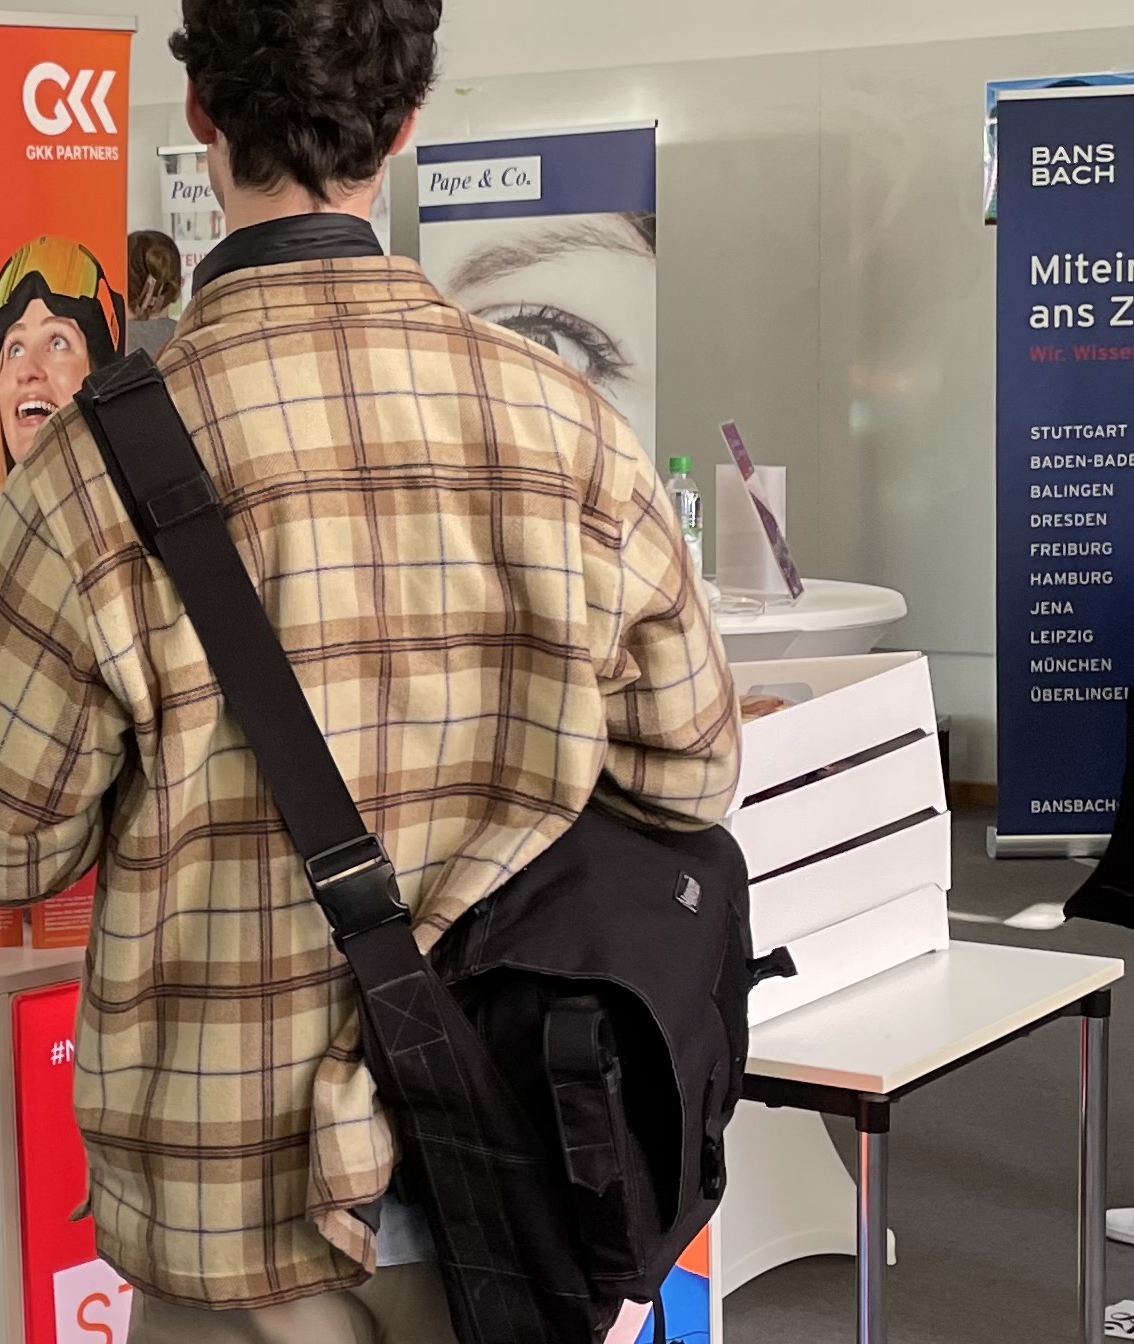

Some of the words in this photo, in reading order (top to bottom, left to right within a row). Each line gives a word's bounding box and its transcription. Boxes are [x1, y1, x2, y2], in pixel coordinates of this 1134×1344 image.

[26, 145, 53, 160] GKK
[56, 145, 119, 161] PARTNERS
[1032, 144, 1115, 167] BANS
[430, 173, 472, 197] Pape
[478, 168, 493, 189] &
[501, 167, 531, 188] Co.
[1032, 165, 1115, 187] BACH
[172, 181, 212, 203] Pape
[1029, 305, 1095, 329] ans
[1029, 347, 1065, 362] Wir.
[1030, 425, 1128, 440] STUTTGART
[1030, 483, 1114, 498] BALINGEN
[1030, 513, 1107, 528] DRESDEN
[1030, 542, 1113, 557] FREIBURG
[1030, 571, 1114, 586] HAMBURG
[1030, 601, 1074, 615] JENA
[1030, 630, 1094, 644] LEIPZIG
[1030, 657, 1112, 673] MÜNCHEN
